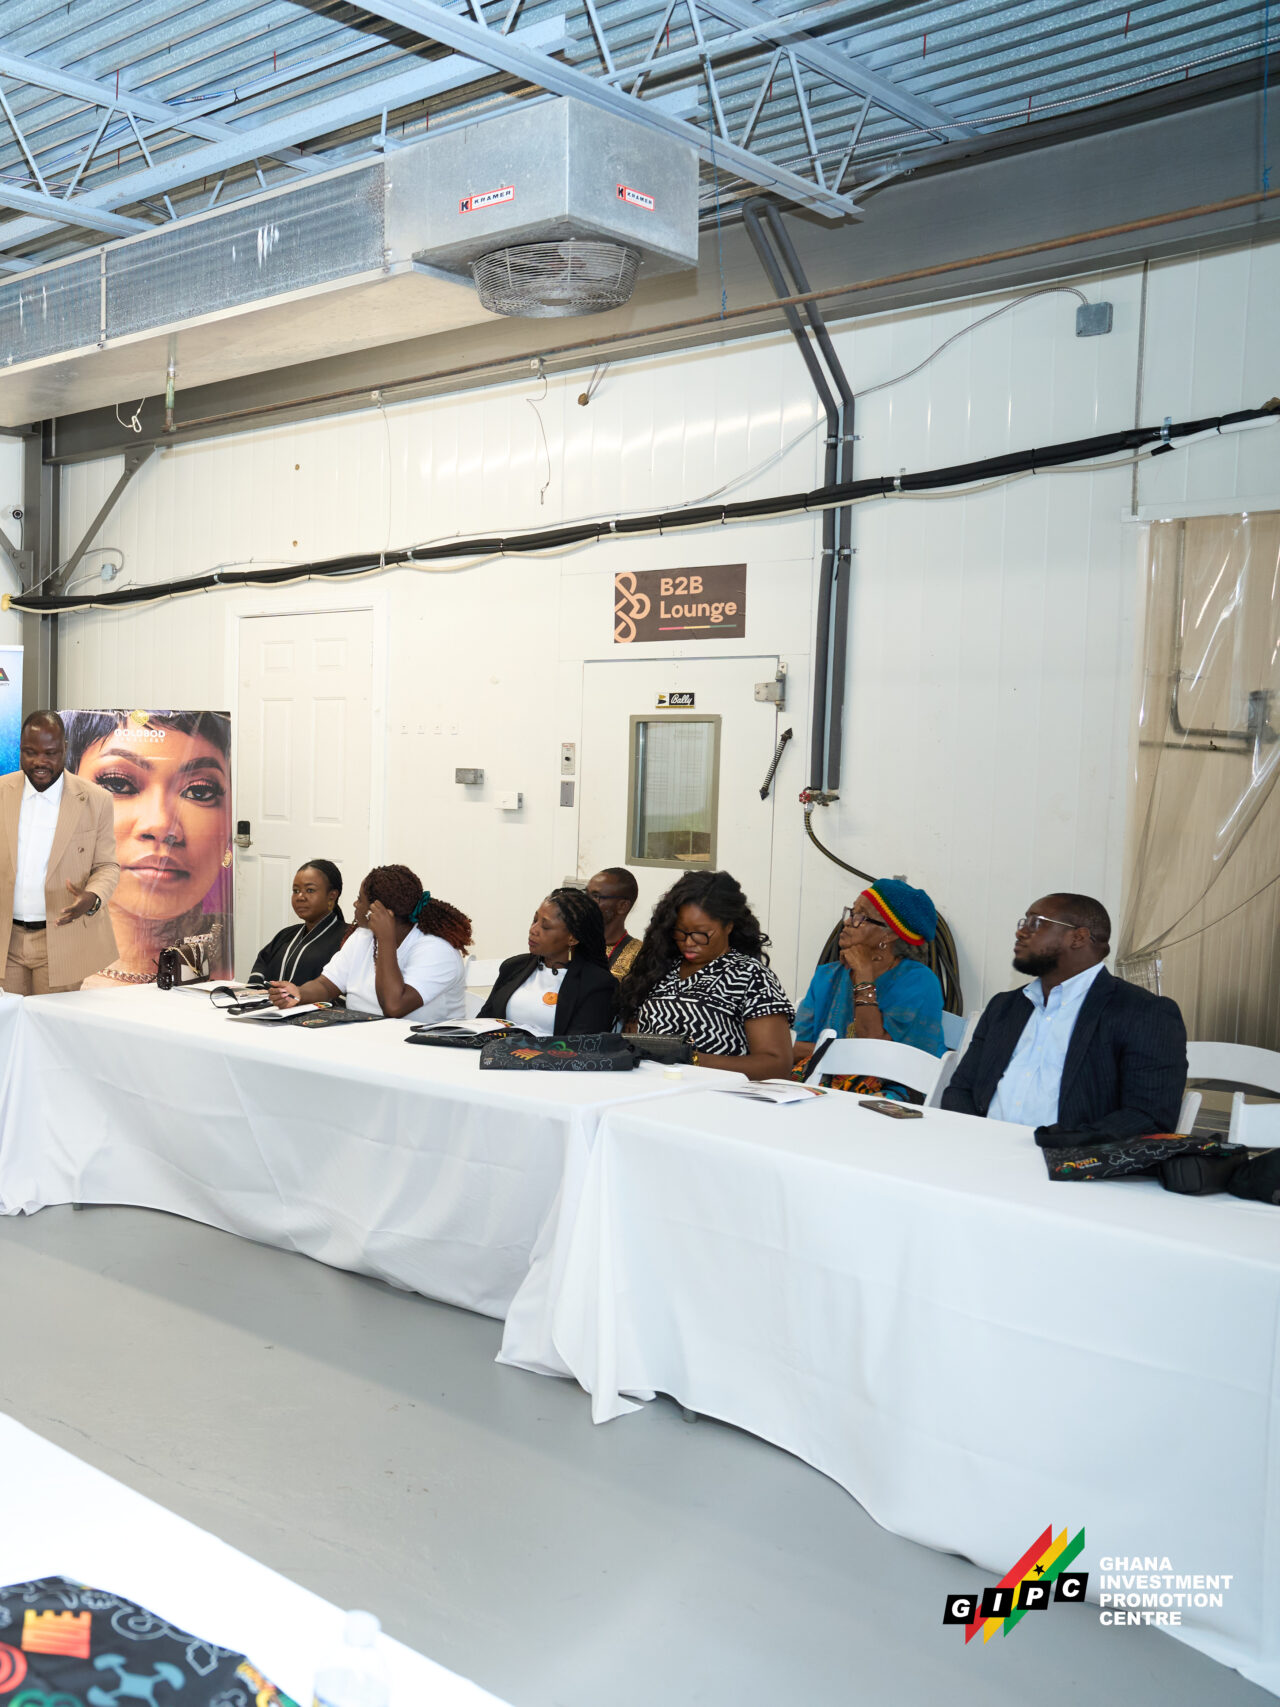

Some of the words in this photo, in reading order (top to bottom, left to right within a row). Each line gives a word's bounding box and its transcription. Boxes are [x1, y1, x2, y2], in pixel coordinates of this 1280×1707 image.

[461, 201, 469, 211] K
[474, 190, 512, 205] KRAMER
[617, 187, 624, 198] K
[627, 192, 653, 205] KRAMER
[660, 575, 703, 596] B2B
[660, 601, 738, 623] Lounge
[671, 693, 693, 705] Bally
[114, 728, 166, 738] GOLDBOD
